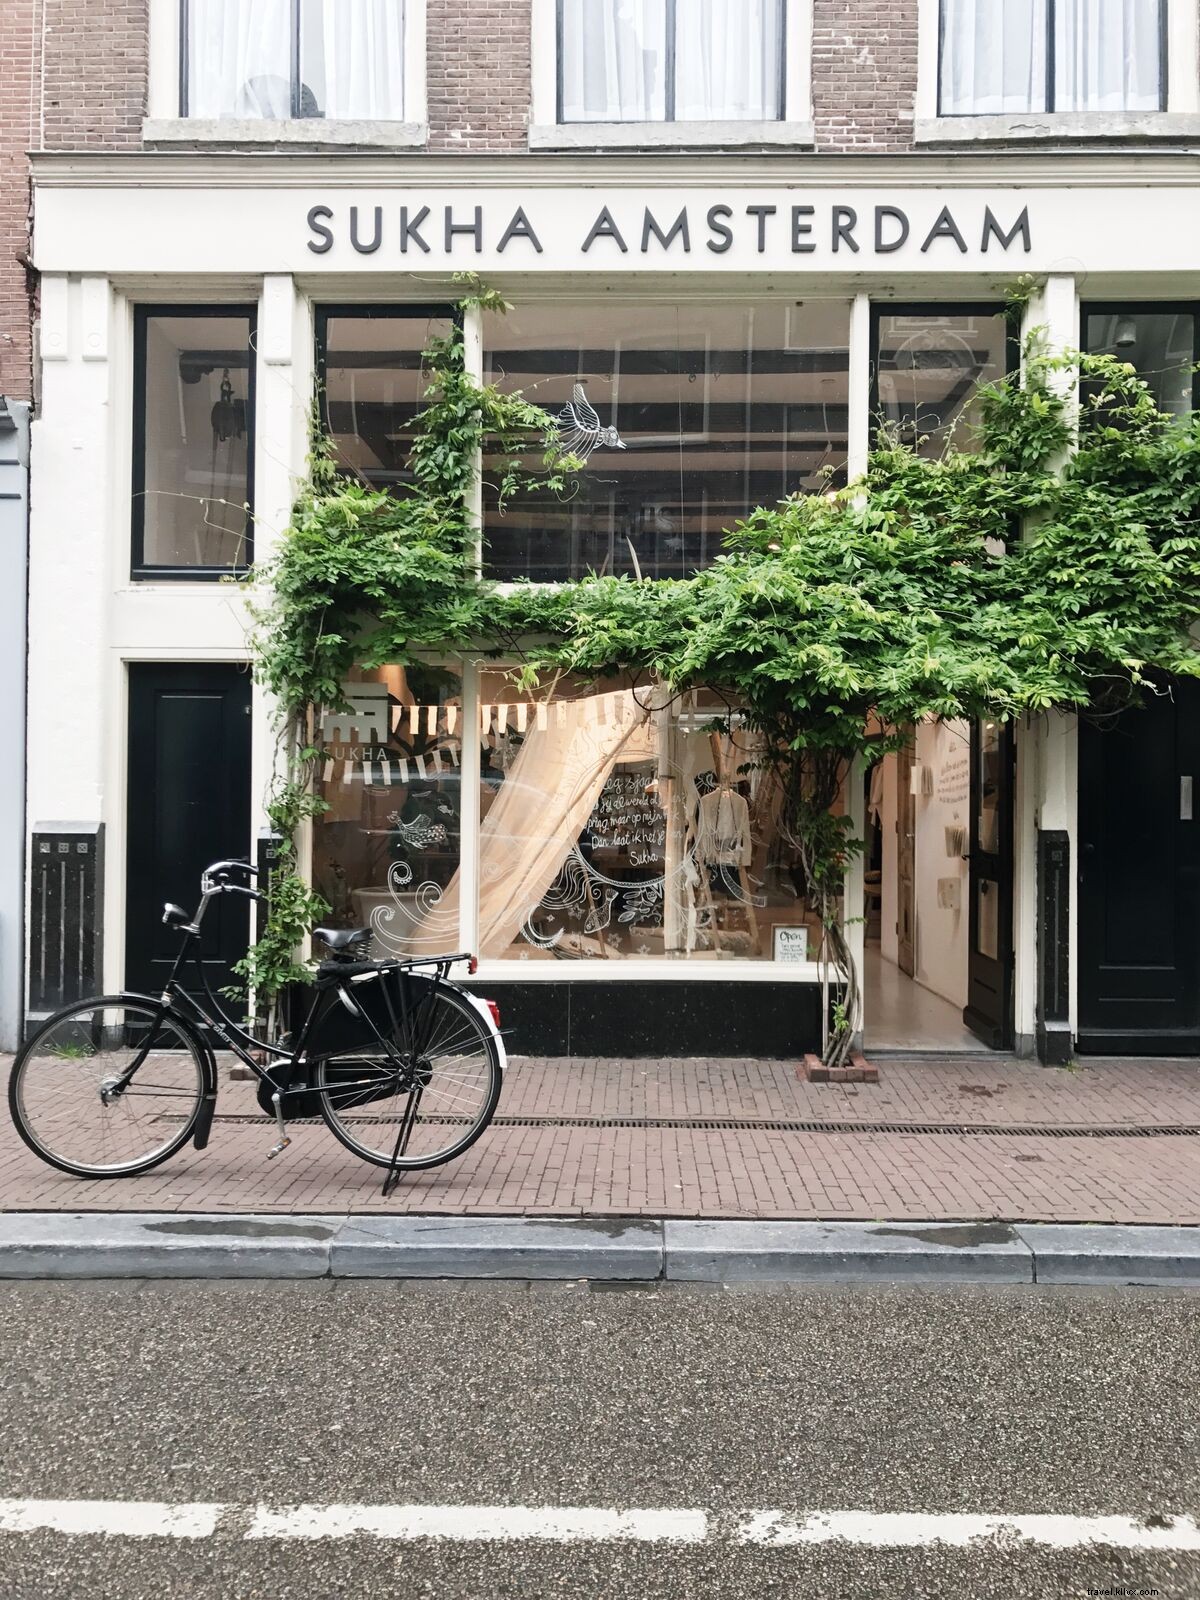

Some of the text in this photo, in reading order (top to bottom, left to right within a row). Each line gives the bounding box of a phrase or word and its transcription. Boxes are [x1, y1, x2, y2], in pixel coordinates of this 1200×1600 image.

[306, 204, 1031, 254] SUKHA AMSTERDAM
[323, 746, 387, 761] SUKHA
[631, 814, 641, 828] op
[591, 835, 609, 850] Dan
[610, 828, 631, 846] laat
[632, 829, 642, 844] ik
[642, 829, 656, 843] het
[629, 850, 659, 867] Sukha
[779, 930, 802, 943] Open
